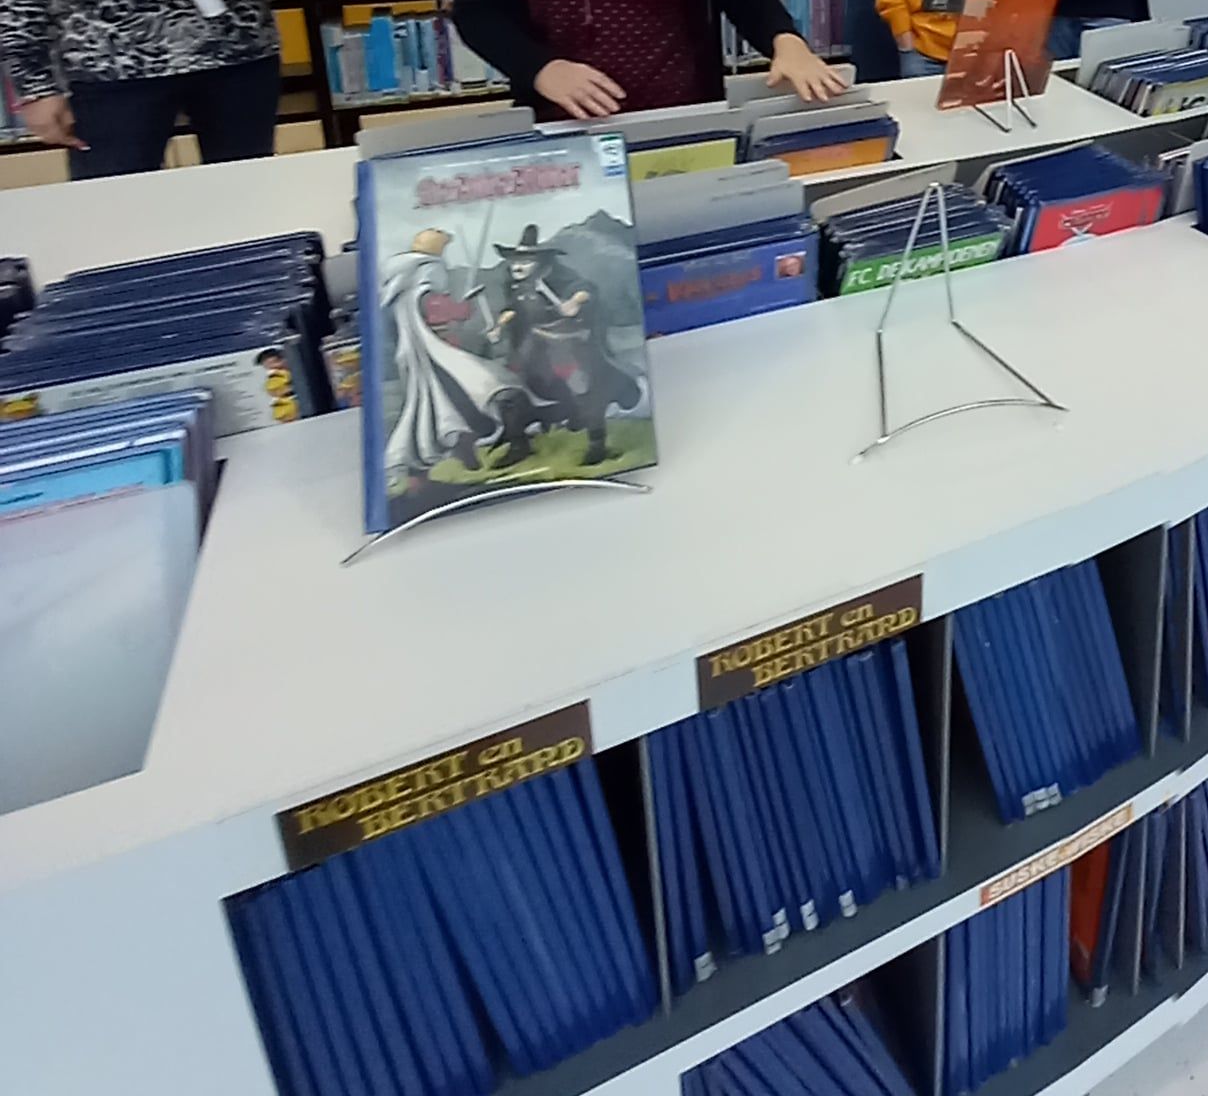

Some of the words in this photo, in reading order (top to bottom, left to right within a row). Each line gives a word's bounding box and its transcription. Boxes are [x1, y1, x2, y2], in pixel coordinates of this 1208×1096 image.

[848, 267, 873, 287] FC
[707, 612, 835, 678] ROBERT
[294, 750, 470, 836] ROBERT
